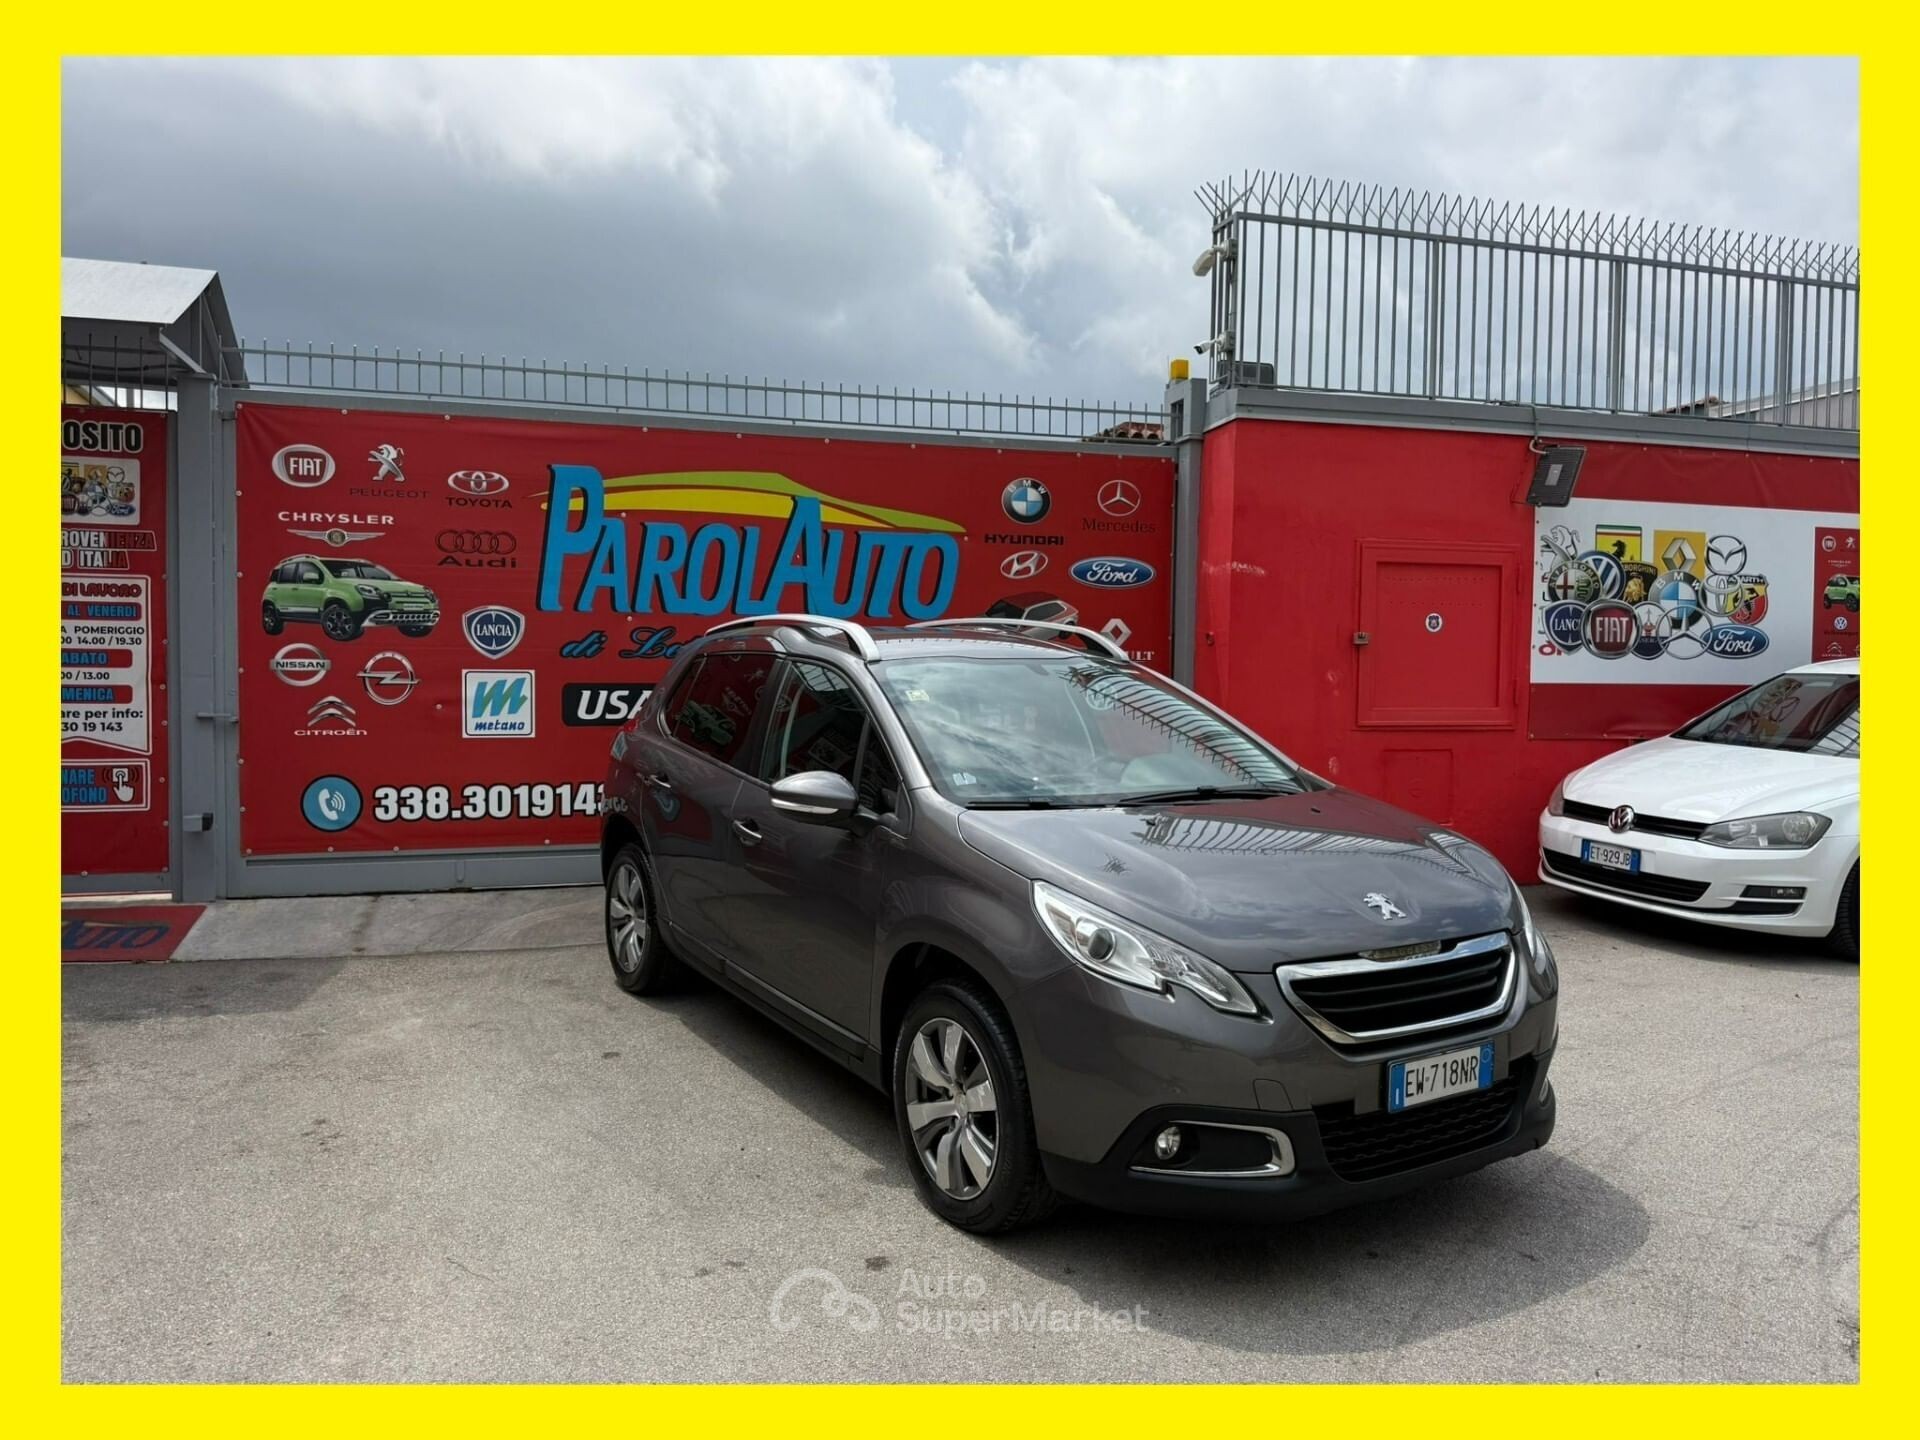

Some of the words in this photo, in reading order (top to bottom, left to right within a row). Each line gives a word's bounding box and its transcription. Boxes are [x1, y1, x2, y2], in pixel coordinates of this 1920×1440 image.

[289, 457, 324, 476] FIAT
[350, 487, 429, 499] PEUGEOT
[447, 496, 513, 509] TOYOTA
[278, 511, 394, 525] CHRYSLER
[1082, 518, 1156, 533] Mercedes
[984, 534, 1064, 546] HYUNDAI
[79, 550, 127, 568] ITALIA
[437, 555, 518, 568] Audi
[1086, 560, 1138, 583] Ford
[80, 583, 142, 597] LAVORO
[74, 626, 144, 635] POMERIGGIO
[476, 623, 513, 637] LANCIA
[1595, 617, 1630, 643] FIAT
[77, 636, 106, 645] 14.00
[115, 637, 142, 646] 19.30
[1713, 629, 1755, 653] Ford
[275, 661, 326, 671] NISSAN
[82, 671, 110, 680] 13.00
[85, 709, 108, 720] per
[112, 707, 144, 719] info:
[82, 721, 97, 732] 19
[100, 721, 123, 732] 143
[474, 720, 525, 731] metano
[374, 785, 604, 821] 338.301914
